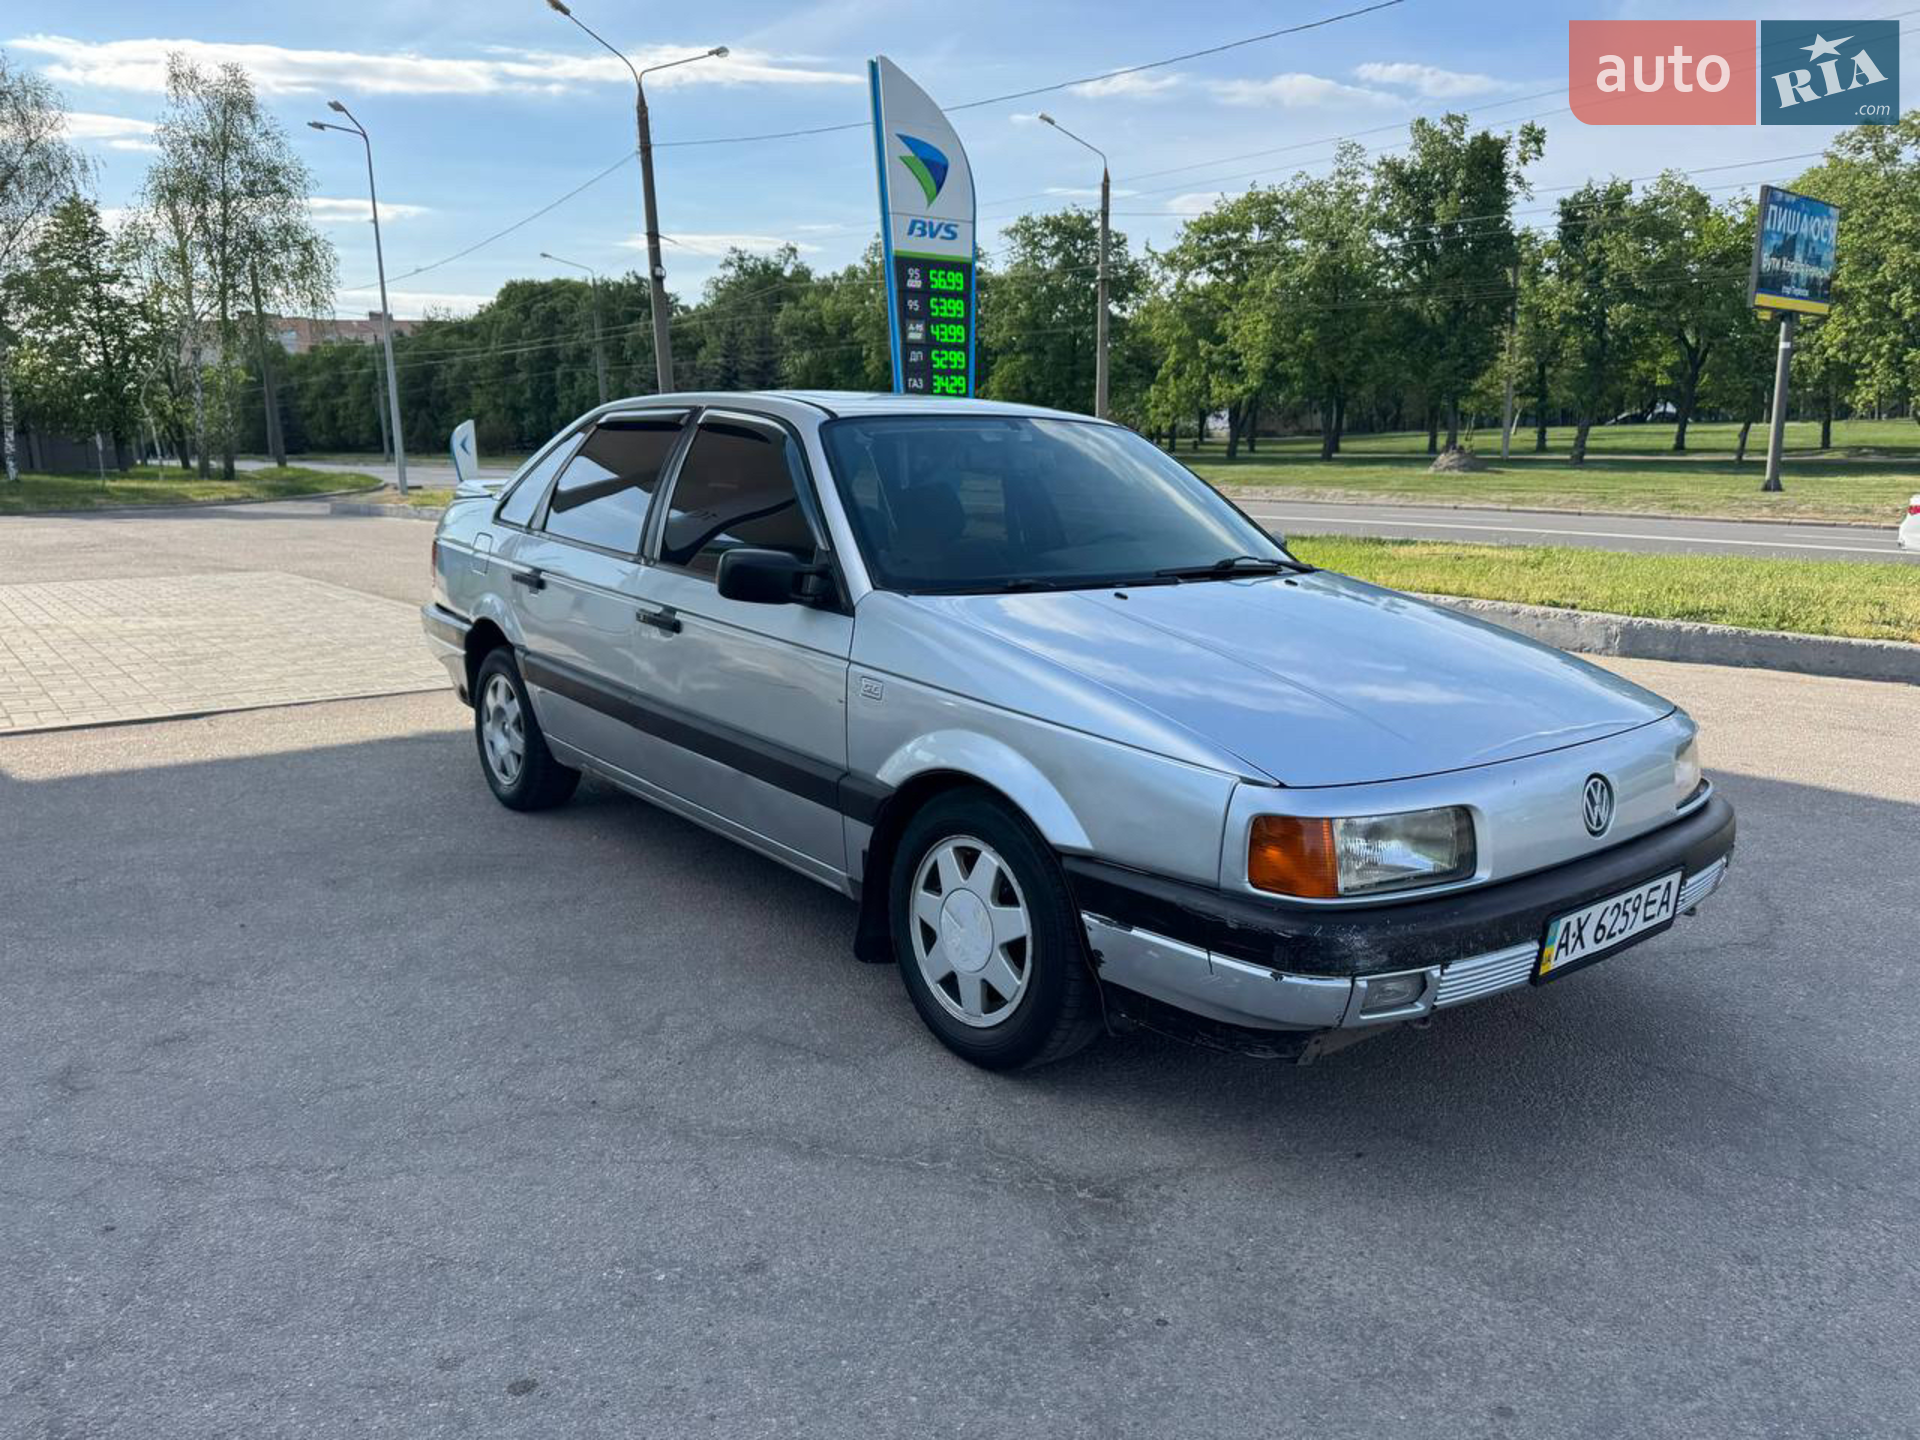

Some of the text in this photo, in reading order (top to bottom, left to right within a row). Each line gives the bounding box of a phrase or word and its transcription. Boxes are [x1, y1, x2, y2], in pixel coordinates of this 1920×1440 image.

[907, 219, 959, 241] BVS
[908, 267, 920, 280] 95
[907, 300, 919, 311] 95
[908, 378, 923, 389] ГАЗ
[1593, 893, 1643, 945] 6259
